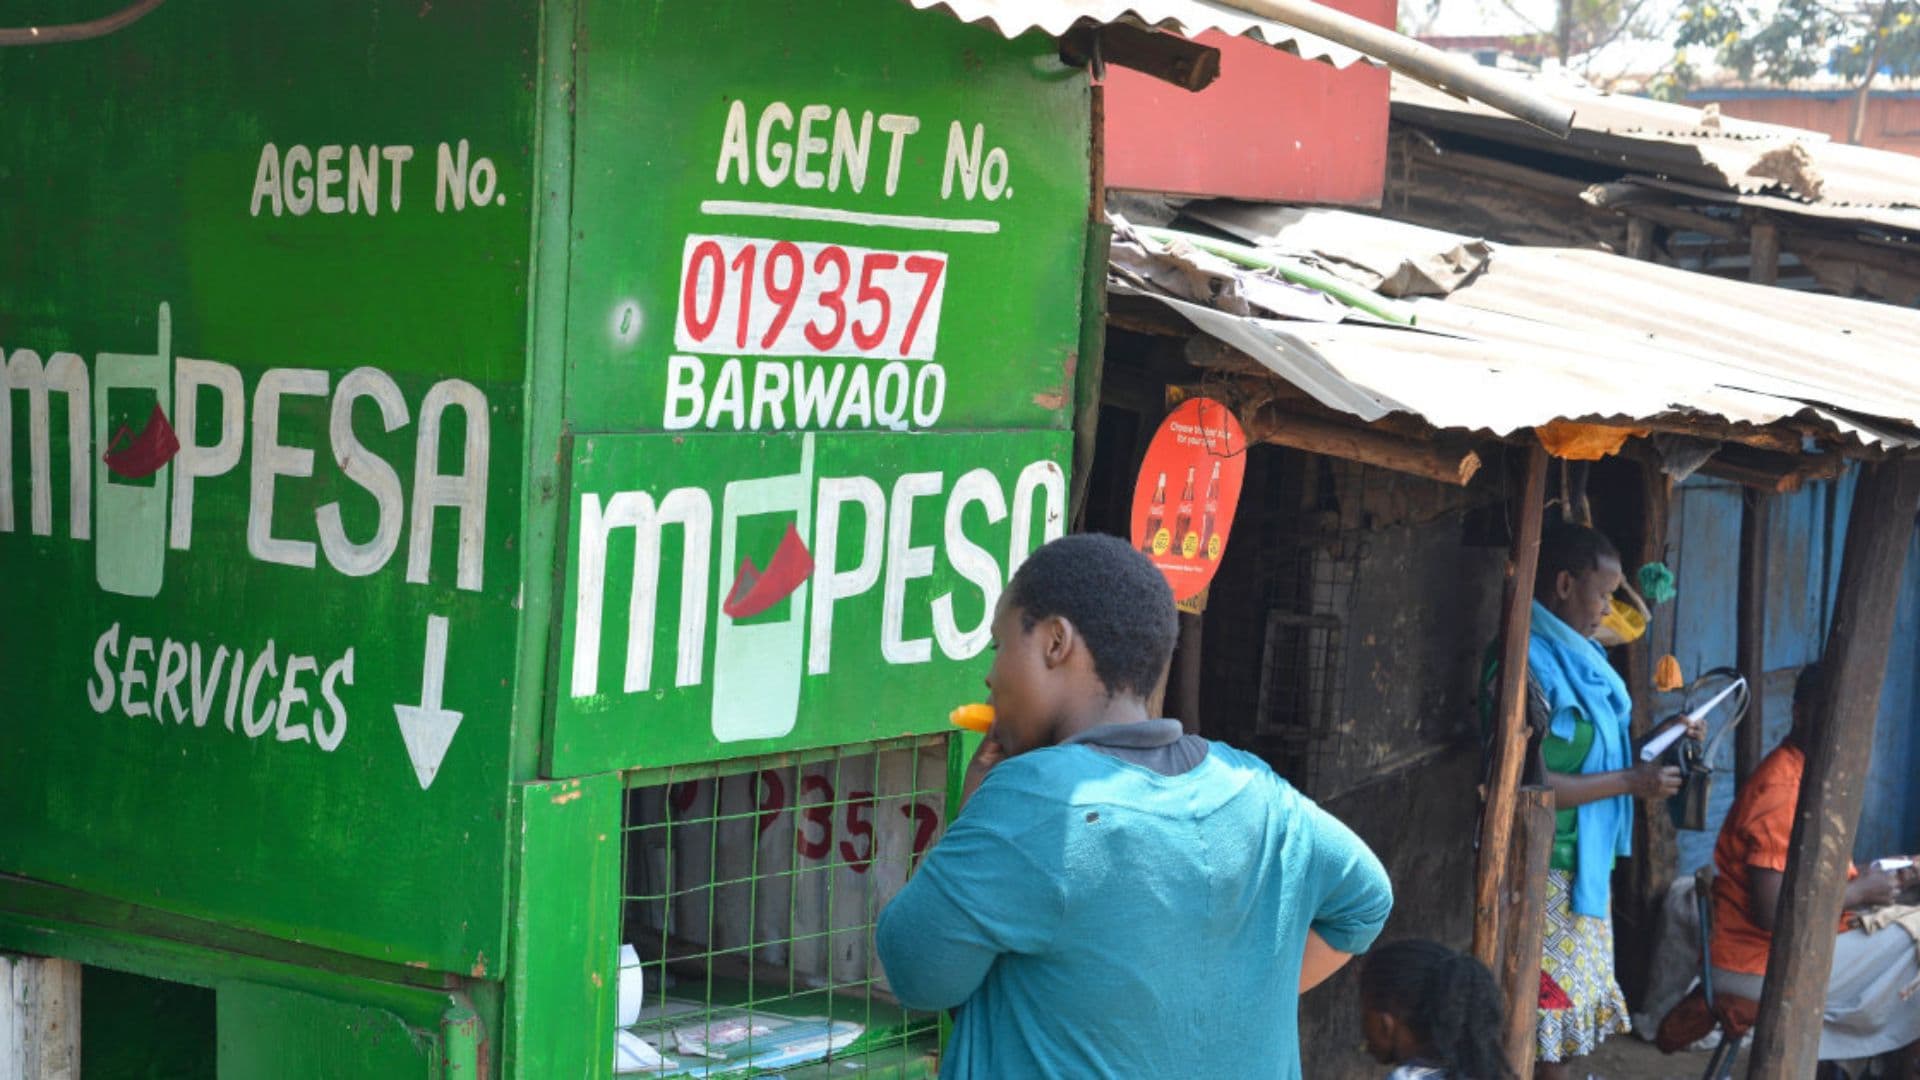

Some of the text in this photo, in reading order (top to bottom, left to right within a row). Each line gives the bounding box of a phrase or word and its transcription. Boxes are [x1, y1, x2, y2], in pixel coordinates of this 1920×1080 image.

[250, 138, 506, 217] AGENT No.
[716, 99, 1014, 201] AGENT No.
[683, 240, 945, 357] 019357
[663, 355, 946, 431] BARWAQO
[87, 622, 354, 752] SERVICES
